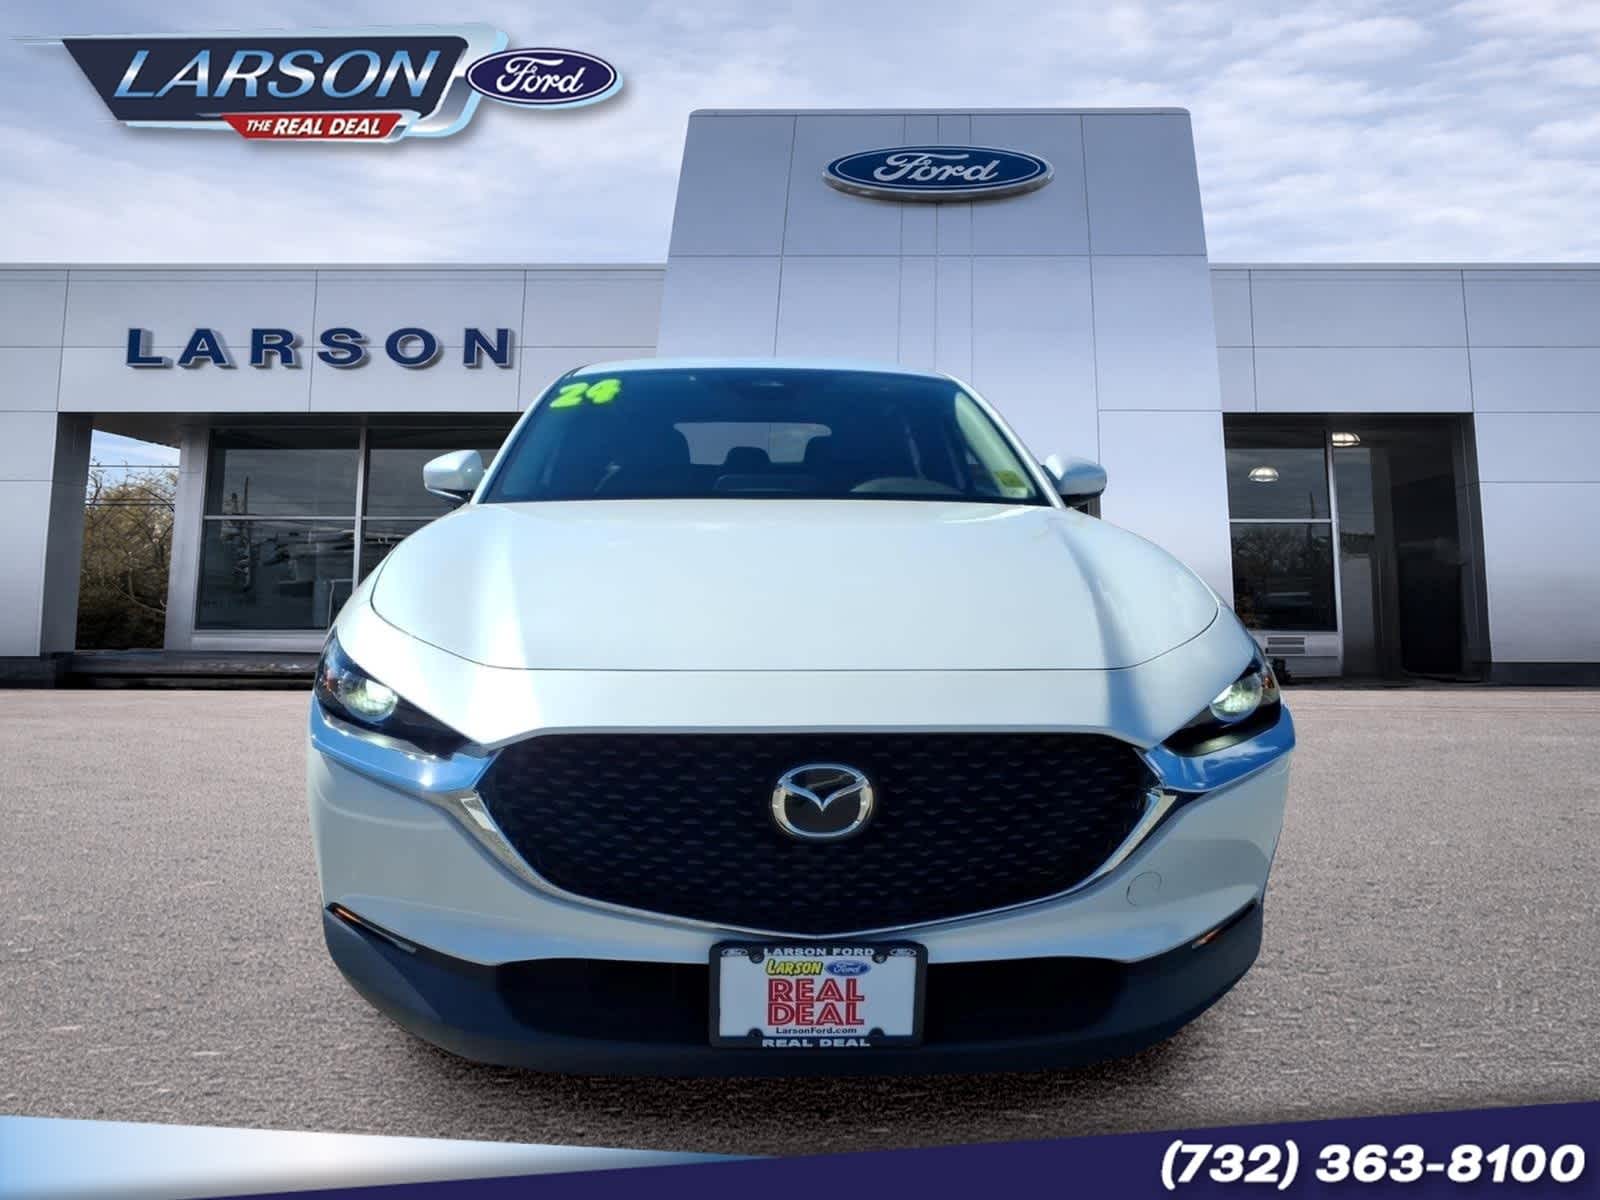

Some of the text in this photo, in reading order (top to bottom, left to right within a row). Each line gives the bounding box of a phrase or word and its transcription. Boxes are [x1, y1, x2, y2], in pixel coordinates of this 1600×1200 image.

[873, 152, 1000, 182] Ford
[126, 328, 512, 368] LARSON
[550, 379, 621, 408] 24
[763, 947, 875, 957] LARSON FORD
[767, 978, 865, 1002] REAL
[767, 1002, 865, 1026] DEAL
[761, 1038, 871, 1048] REAL DEAL
